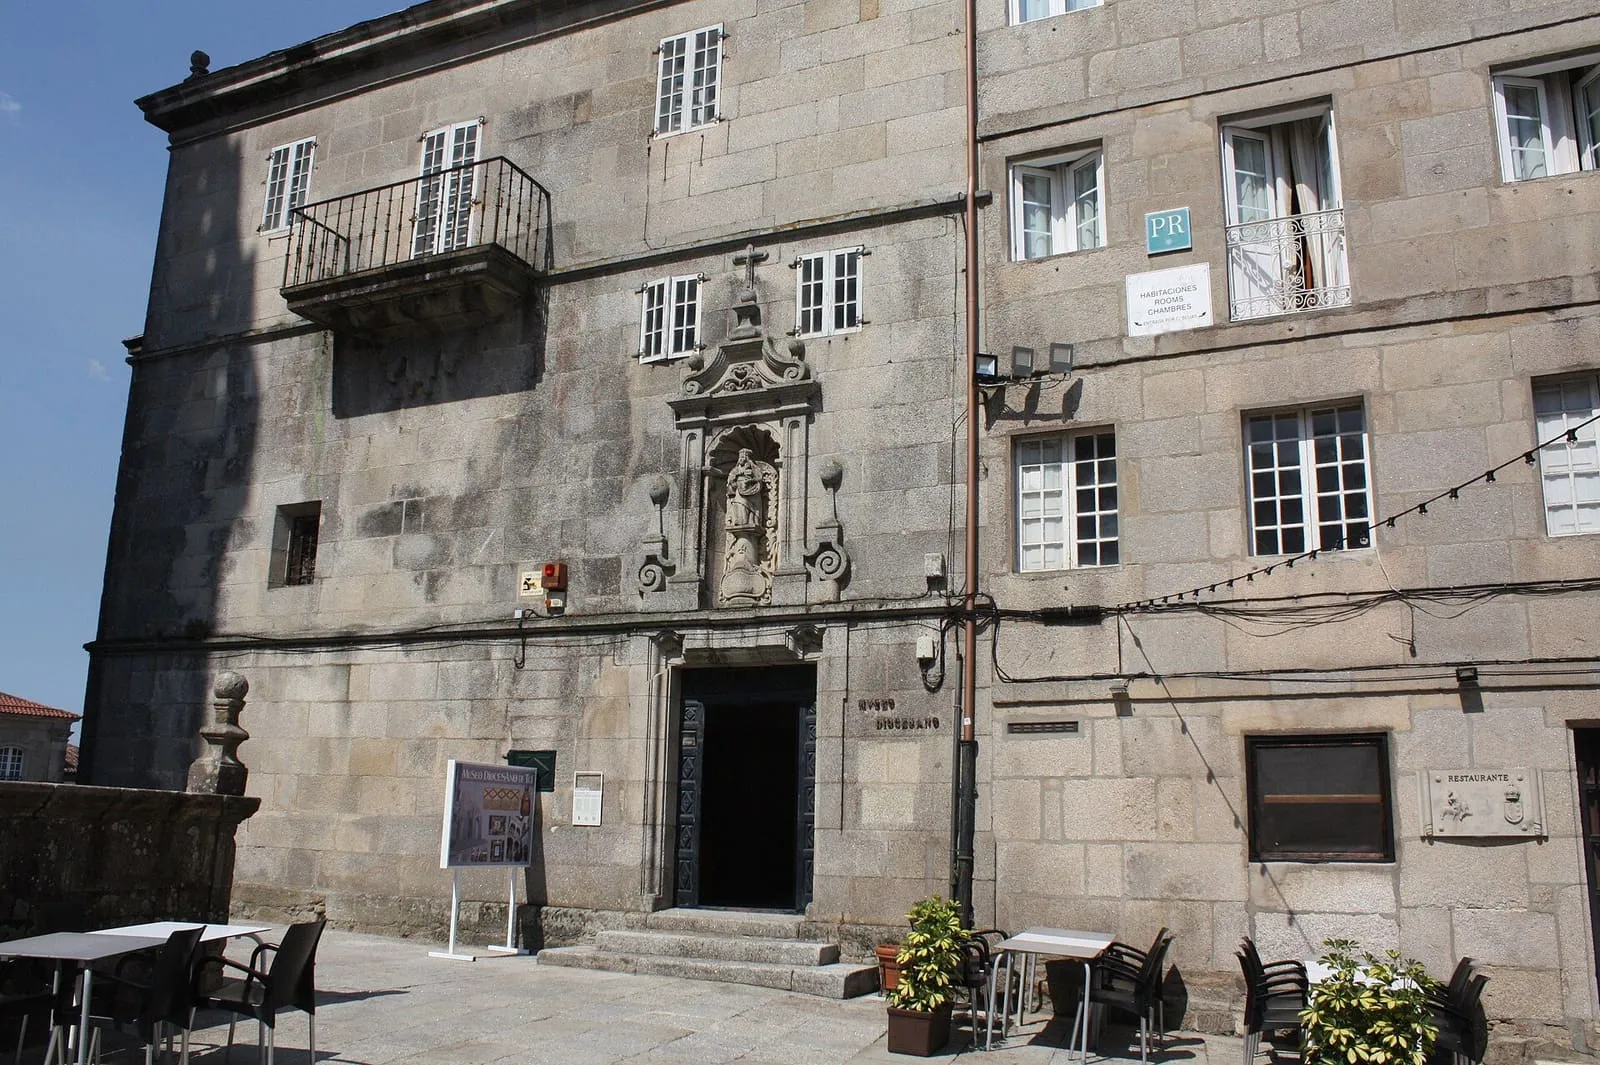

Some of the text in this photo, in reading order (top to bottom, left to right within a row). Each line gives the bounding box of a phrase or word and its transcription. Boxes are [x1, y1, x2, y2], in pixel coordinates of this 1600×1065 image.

[1151, 214, 1185, 238] PR
[1140, 284, 1198, 299] HABITACIONES
[1154, 296, 1184, 305] ROOMS
[1147, 303, 1192, 316] CHAMBRES
[876, 717, 939, 730] DIOCESANO
[1448, 774, 1509, 782] RESTAURANTE
